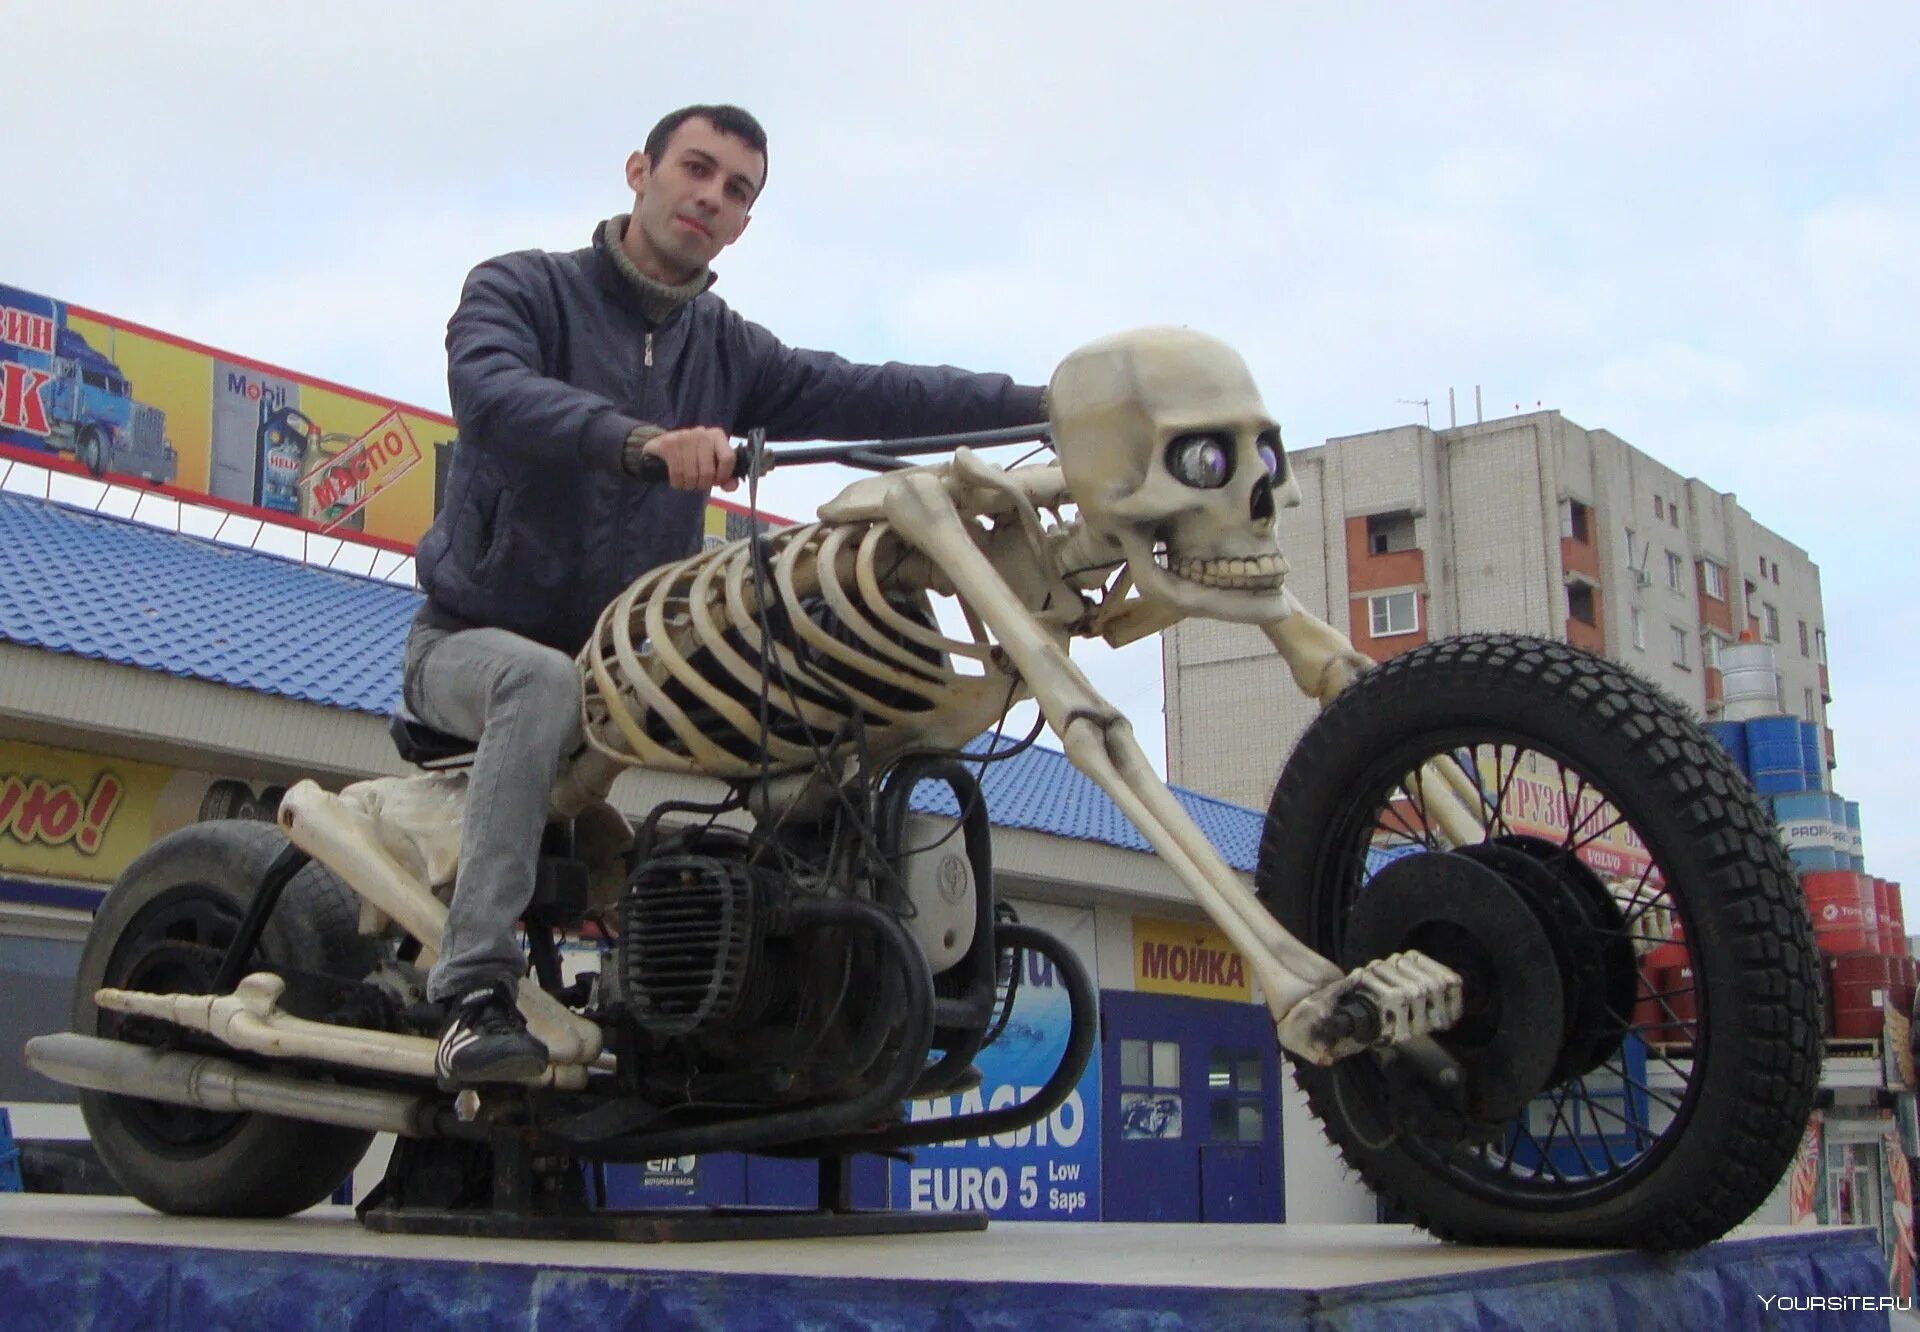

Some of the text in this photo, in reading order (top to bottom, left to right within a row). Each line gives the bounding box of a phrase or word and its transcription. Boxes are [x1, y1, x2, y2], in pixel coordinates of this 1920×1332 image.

[228, 373, 286, 407] Mobil
[1587, 849, 1621, 870] VOLVO
[1142, 936, 1244, 988] МОЙКА
[1049, 1159, 1080, 1181] Low
[910, 1165, 1038, 1211] EURO 5
[1049, 1187, 1086, 1213] Saps
